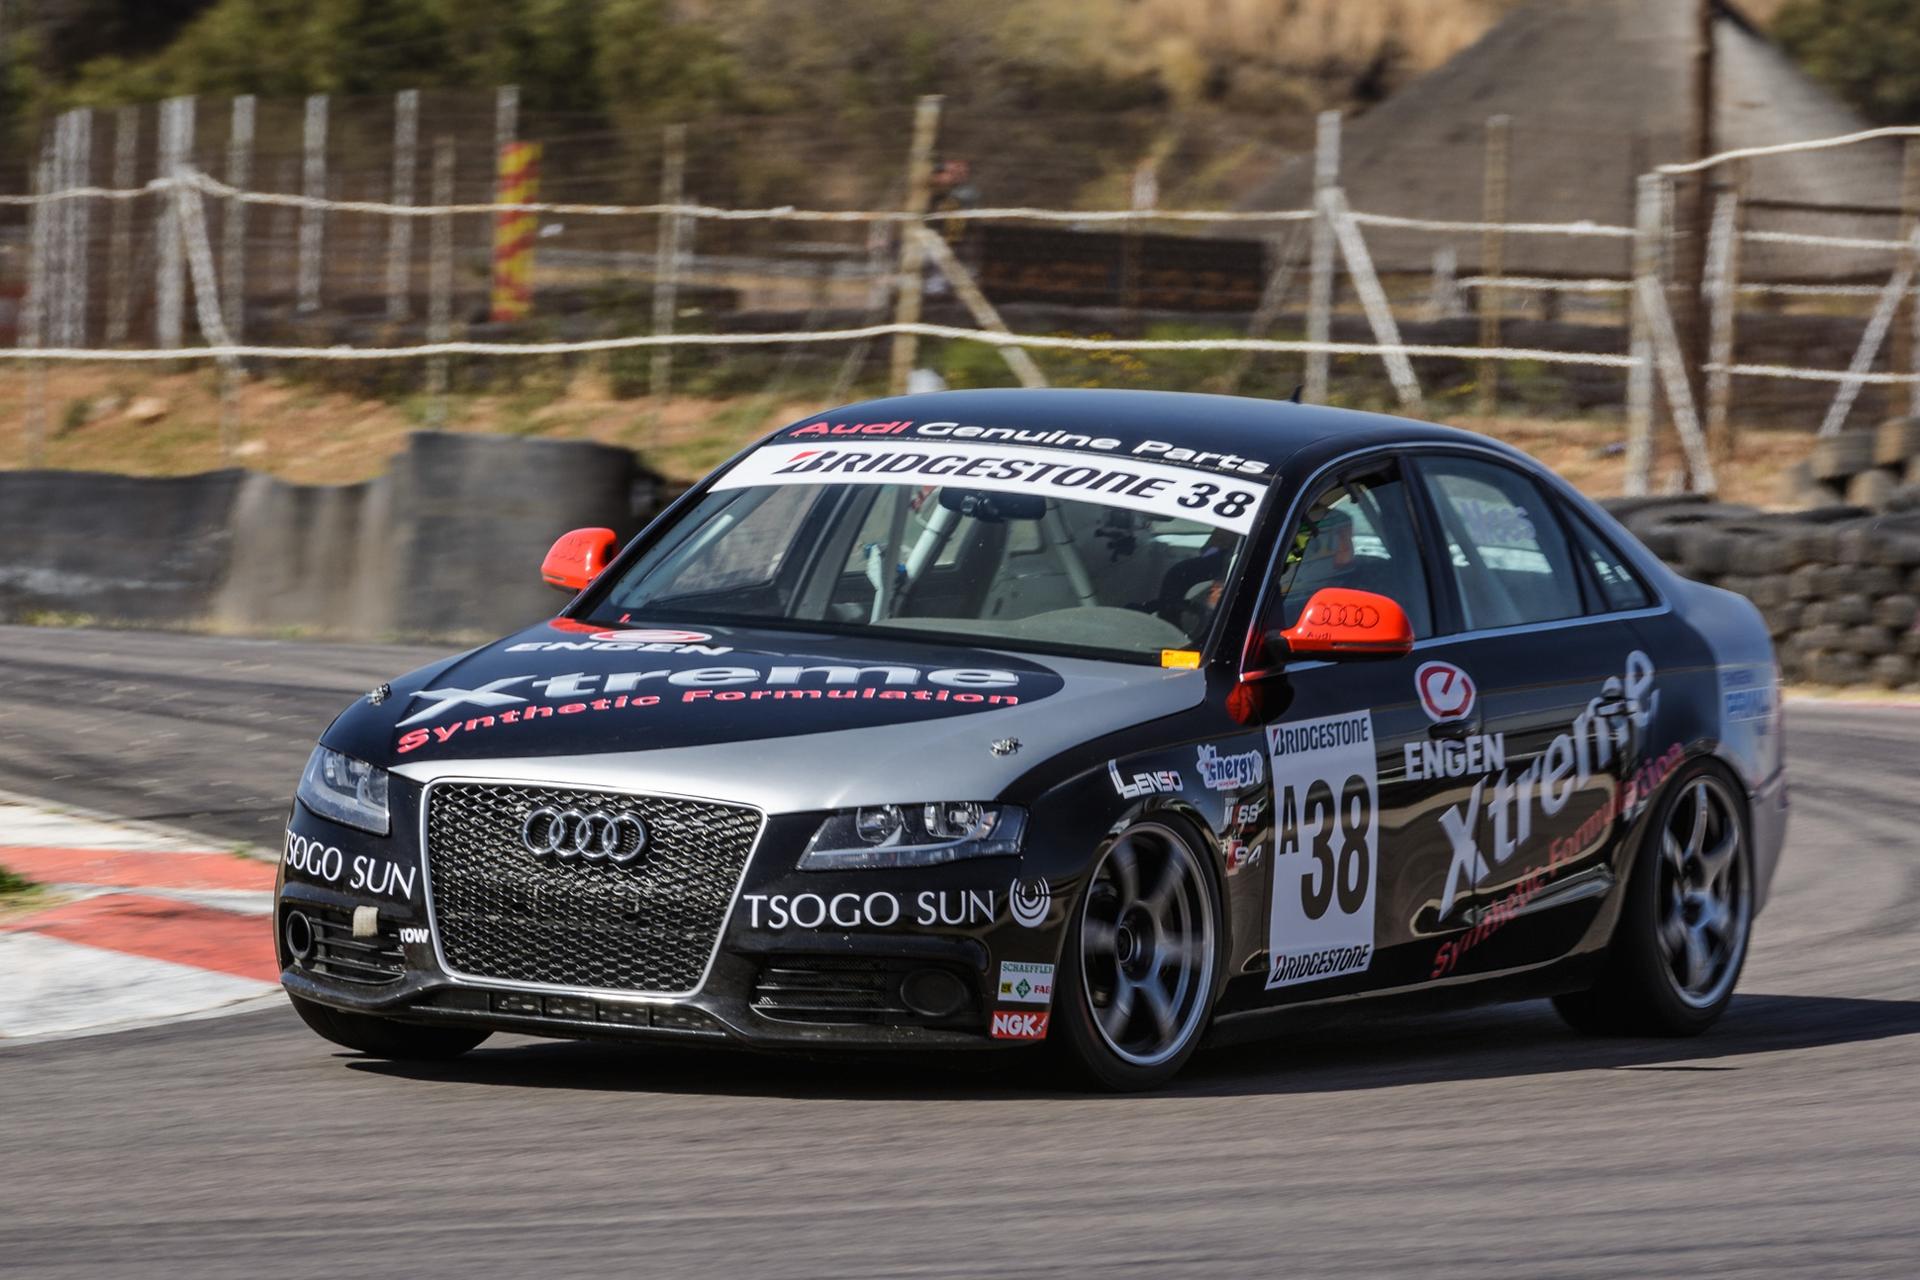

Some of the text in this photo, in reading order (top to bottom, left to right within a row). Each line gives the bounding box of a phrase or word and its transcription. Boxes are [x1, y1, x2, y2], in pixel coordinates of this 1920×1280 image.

[916, 421, 1122, 450] Genuine
[1132, 439, 1271, 475] Parts
[774, 450, 1256, 519] BRIDGESTONE 38
[505, 641, 734, 656] ENGEN
[395, 665, 1020, 728] Xtreme
[396, 687, 1019, 754] Synthetic Formulation
[1272, 717, 1369, 757] BRIDGESTONE
[1403, 732, 1506, 782] ENGEN
[1108, 759, 1184, 800] LENSO
[1438, 650, 1662, 923] Xtreme
[285, 829, 417, 900] TSOGO SUN
[1280, 774, 1372, 920] A38
[743, 889, 995, 929] TSOGO SUN
[1270, 943, 1370, 984] BRIDGESTONE
[992, 1013, 1037, 1037] NGK
